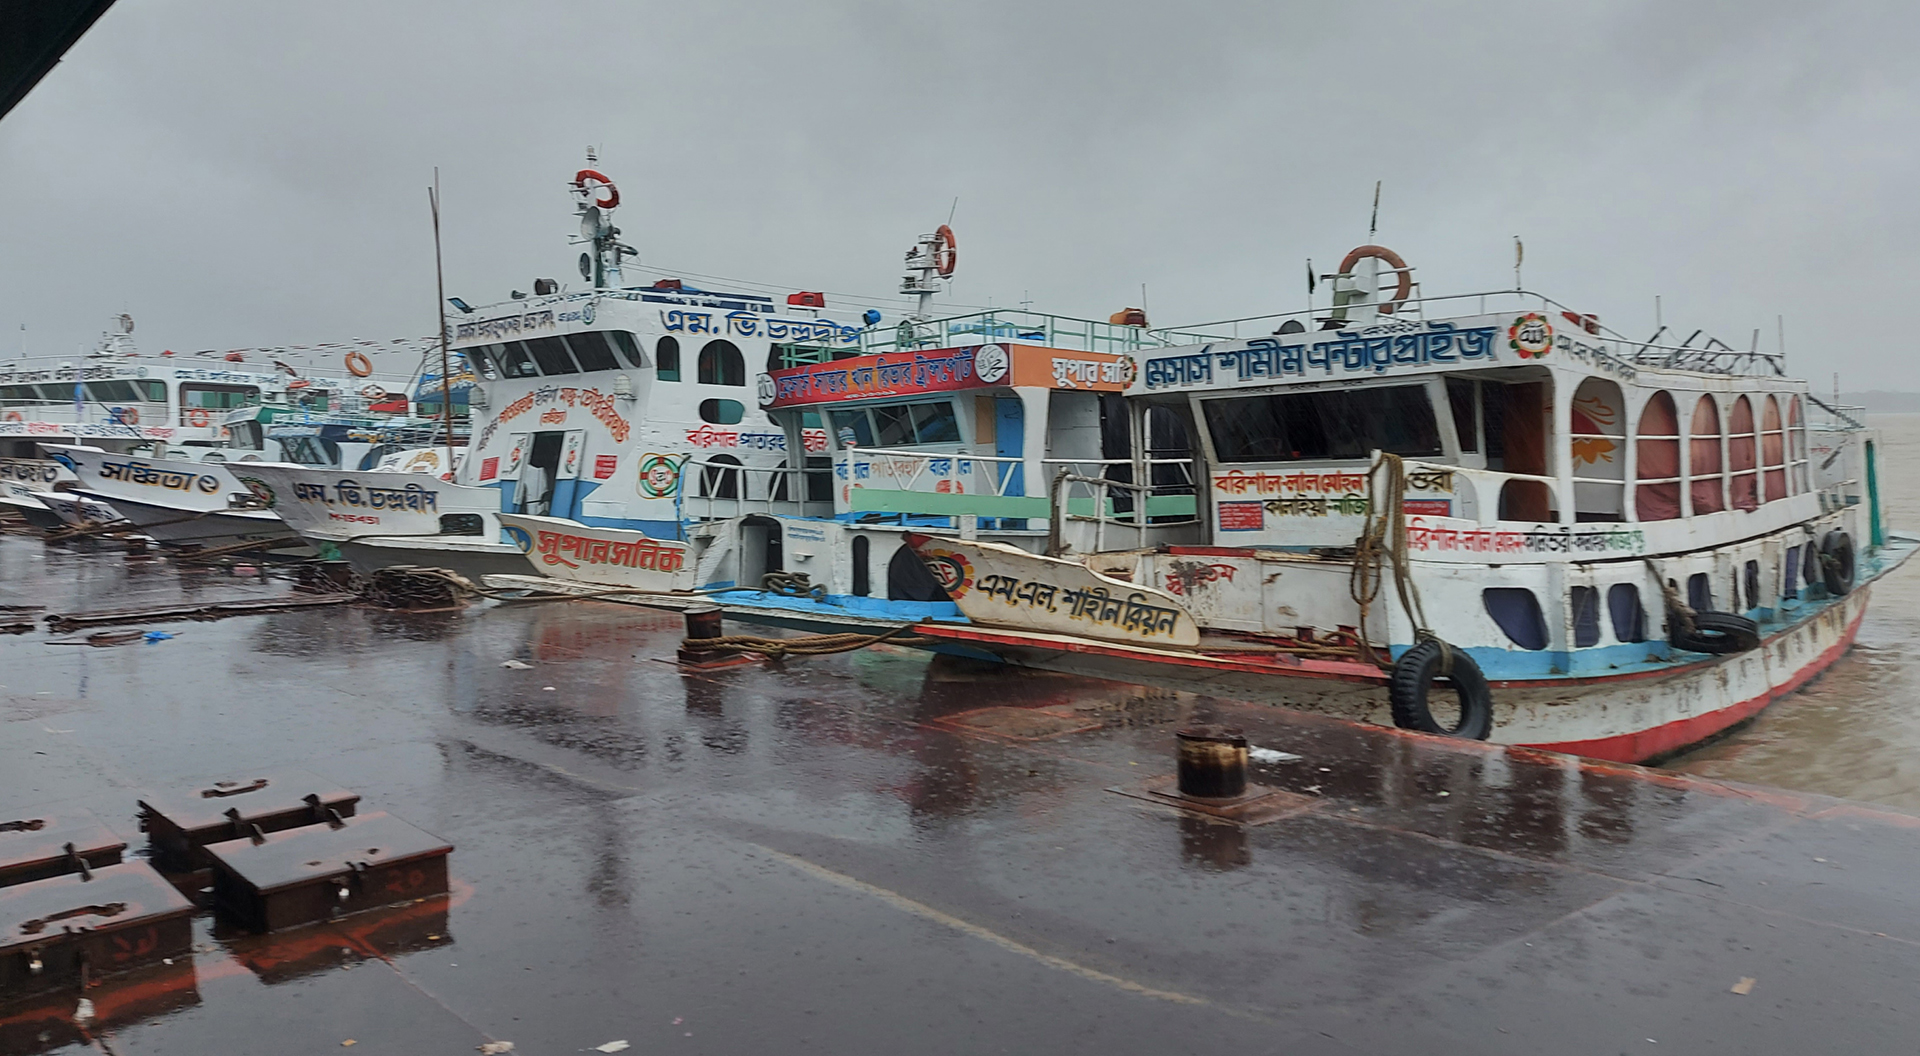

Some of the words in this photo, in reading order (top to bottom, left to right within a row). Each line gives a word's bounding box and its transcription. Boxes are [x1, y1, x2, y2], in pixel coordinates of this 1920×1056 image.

[1052, 357, 1101, 389] সুপার
[1145, 343, 1214, 389] মেসার্স
[1215, 338, 1306, 381] শামীম
[1306, 320, 1503, 375] এন্টারপ্রাইজ
